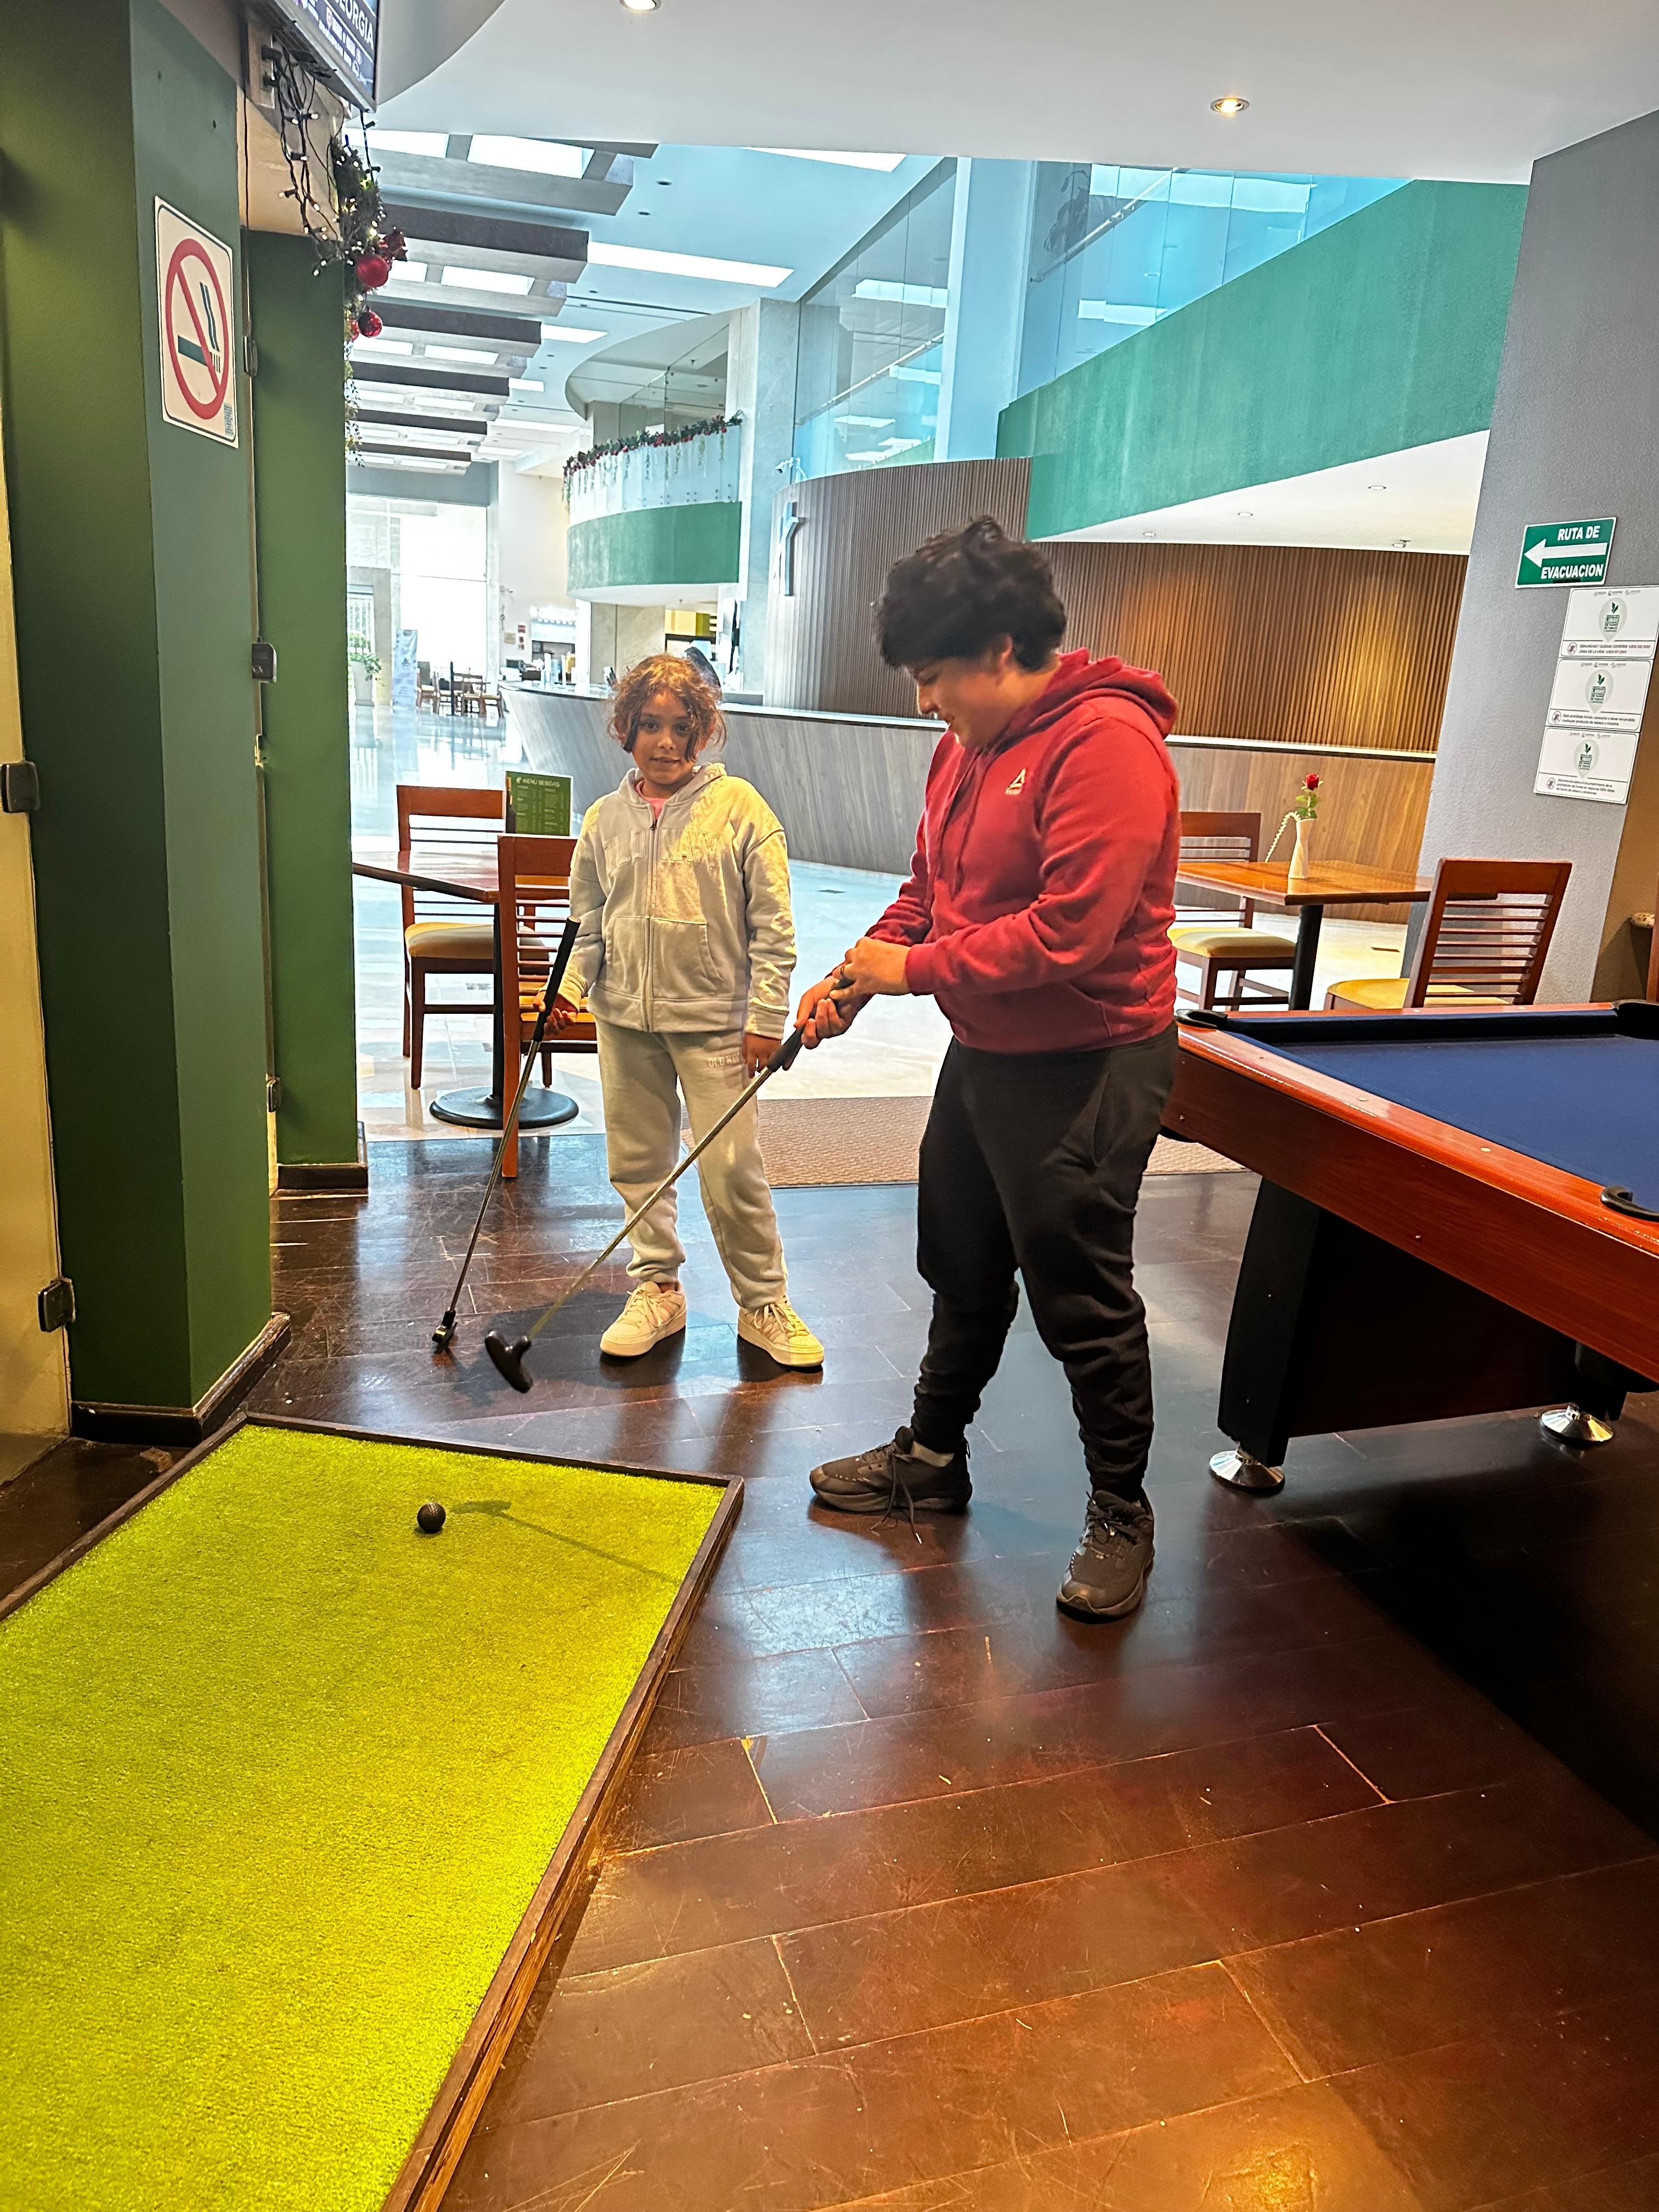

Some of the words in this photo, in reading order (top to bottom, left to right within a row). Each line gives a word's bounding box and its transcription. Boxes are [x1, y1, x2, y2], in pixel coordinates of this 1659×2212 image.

[335, 0, 374, 50] EORGIA
[1558, 527, 1583, 540] RUTA
[1585, 526, 1600, 538] DE
[1541, 564, 1604, 579] EVACUACION
